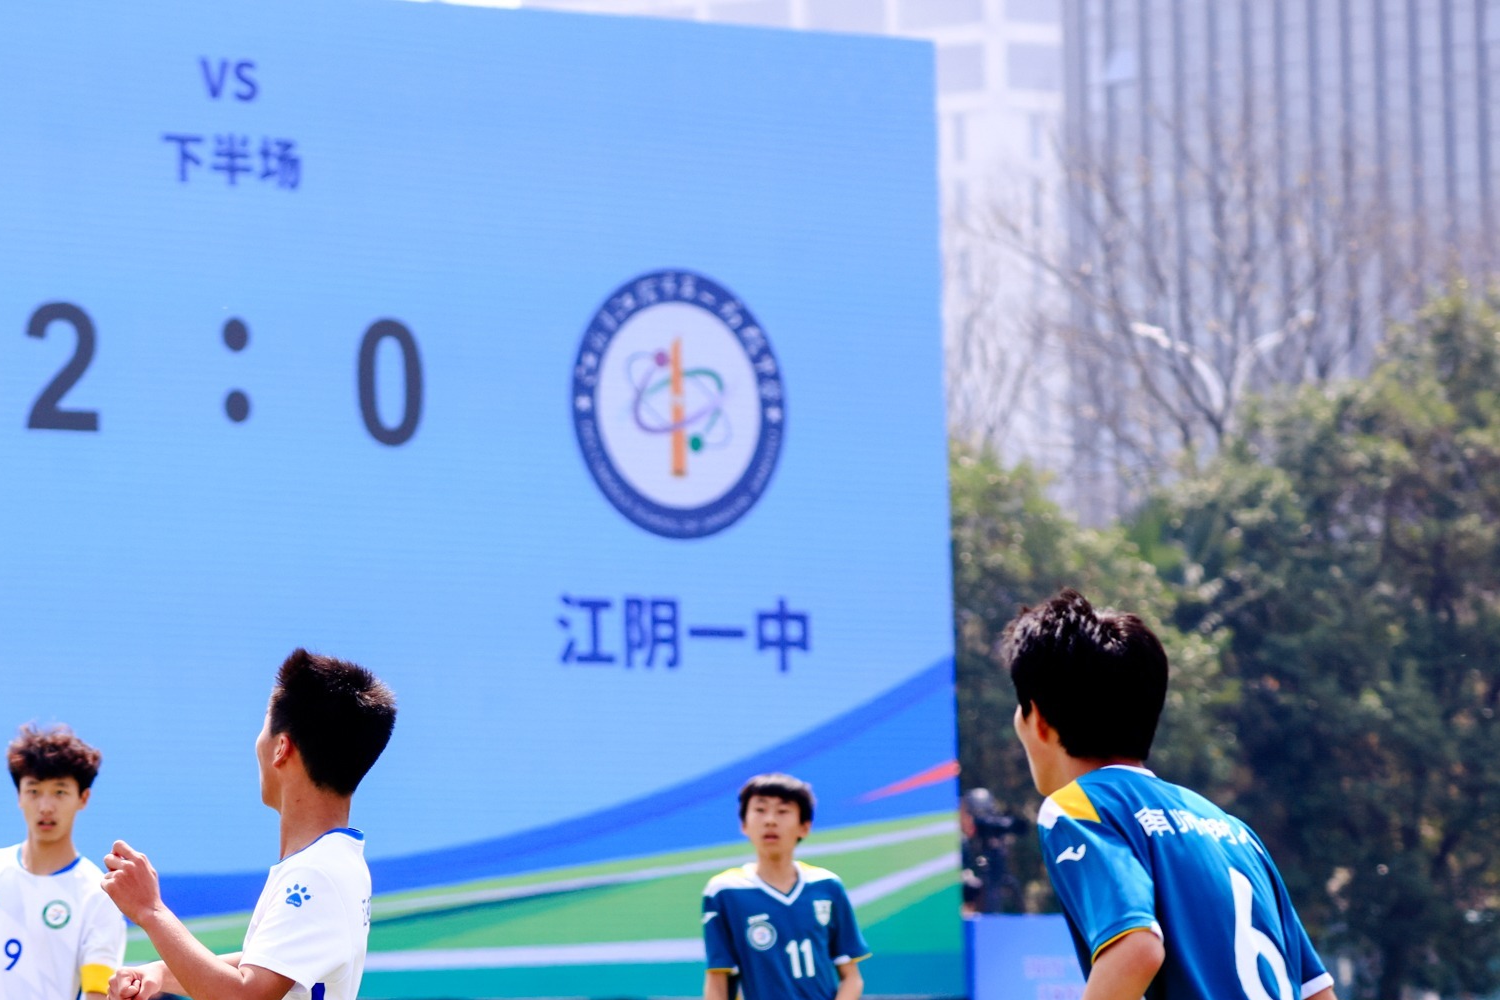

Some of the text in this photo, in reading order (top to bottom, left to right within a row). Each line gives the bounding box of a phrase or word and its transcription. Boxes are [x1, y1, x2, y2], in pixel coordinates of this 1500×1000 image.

[200, 58, 259, 102] VS
[162, 133, 303, 190] 下半场
[26, 302, 99, 432] 2
[357, 318, 424, 447] 0
[557, 595, 812, 674] 江阴一中
[4, 938, 22, 971] 9
[785, 938, 816, 979] 11
